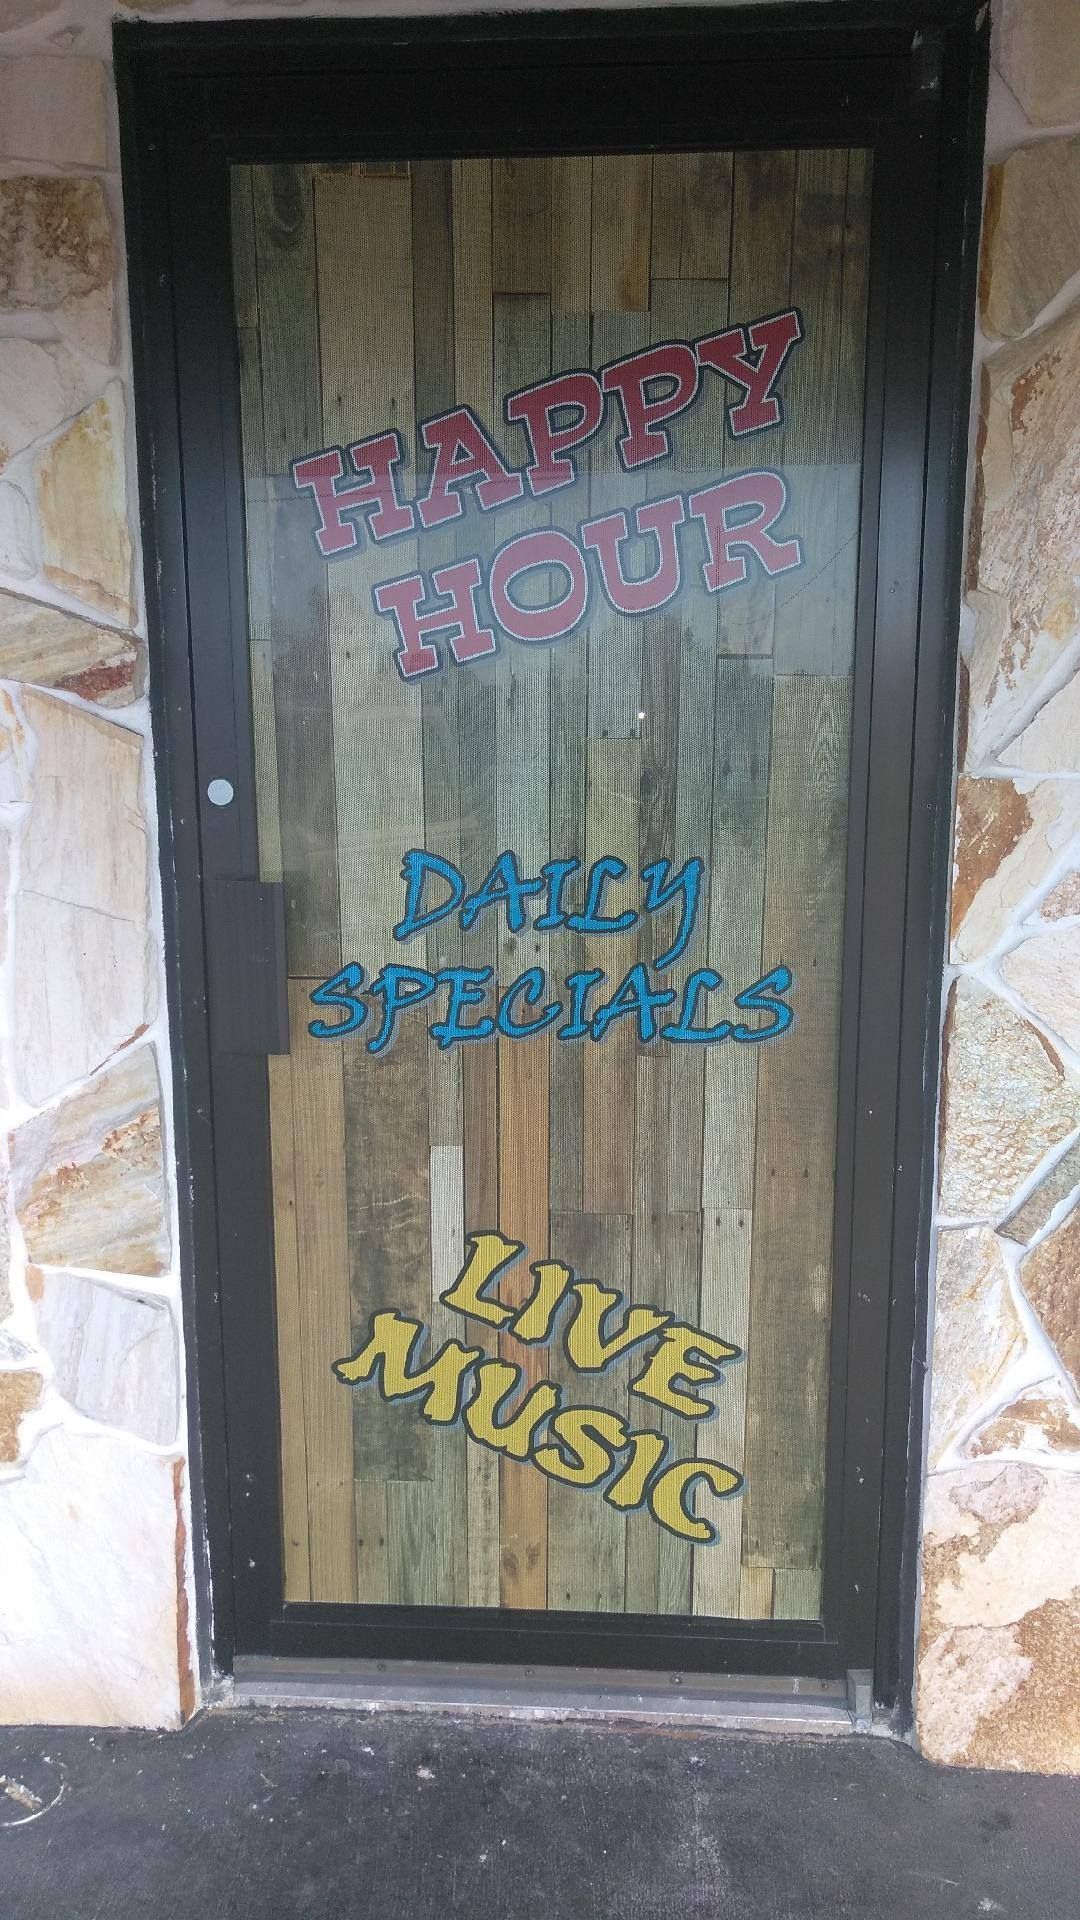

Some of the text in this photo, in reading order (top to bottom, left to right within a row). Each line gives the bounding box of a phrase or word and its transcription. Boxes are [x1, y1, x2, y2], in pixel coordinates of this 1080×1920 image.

[290, 307, 803, 557] HAPPY
[372, 469, 803, 679] HOUR
[307, 961, 796, 1053] SPECIALS
[394, 848, 703, 969] DAILY
[438, 1229, 743, 1419] LIVE
[332, 1310, 743, 1544] MUSIC
